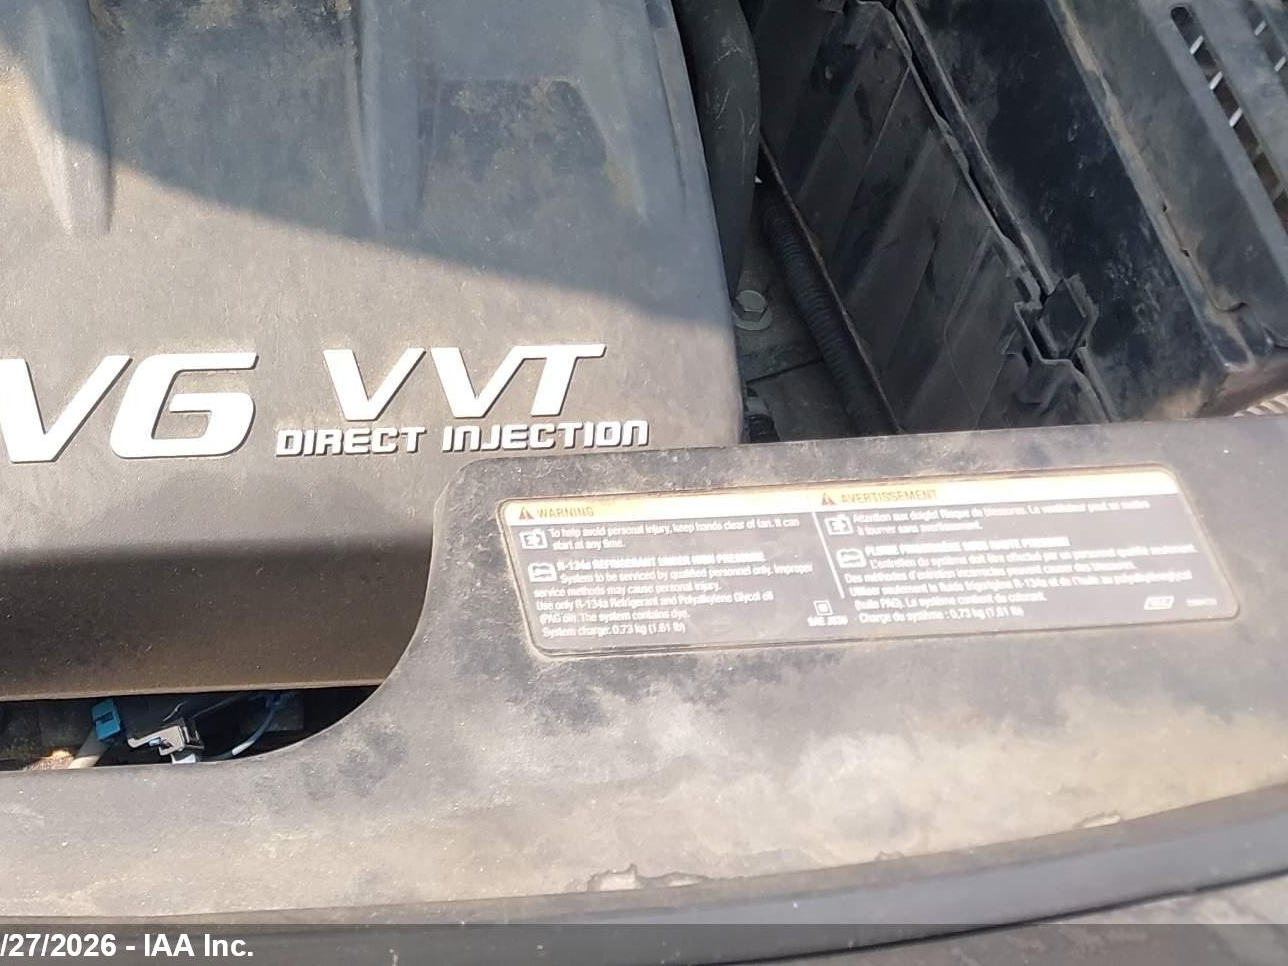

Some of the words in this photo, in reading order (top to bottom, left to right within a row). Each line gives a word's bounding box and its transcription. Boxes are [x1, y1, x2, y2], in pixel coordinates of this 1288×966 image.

[323, 344, 606, 422] VVT
[276, 427, 427, 456] DIRECT
[442, 419, 650, 453] INJECTION
[840, 489, 937, 503] AVERTISSEMENT
[537, 506, 595, 519] WARNING
